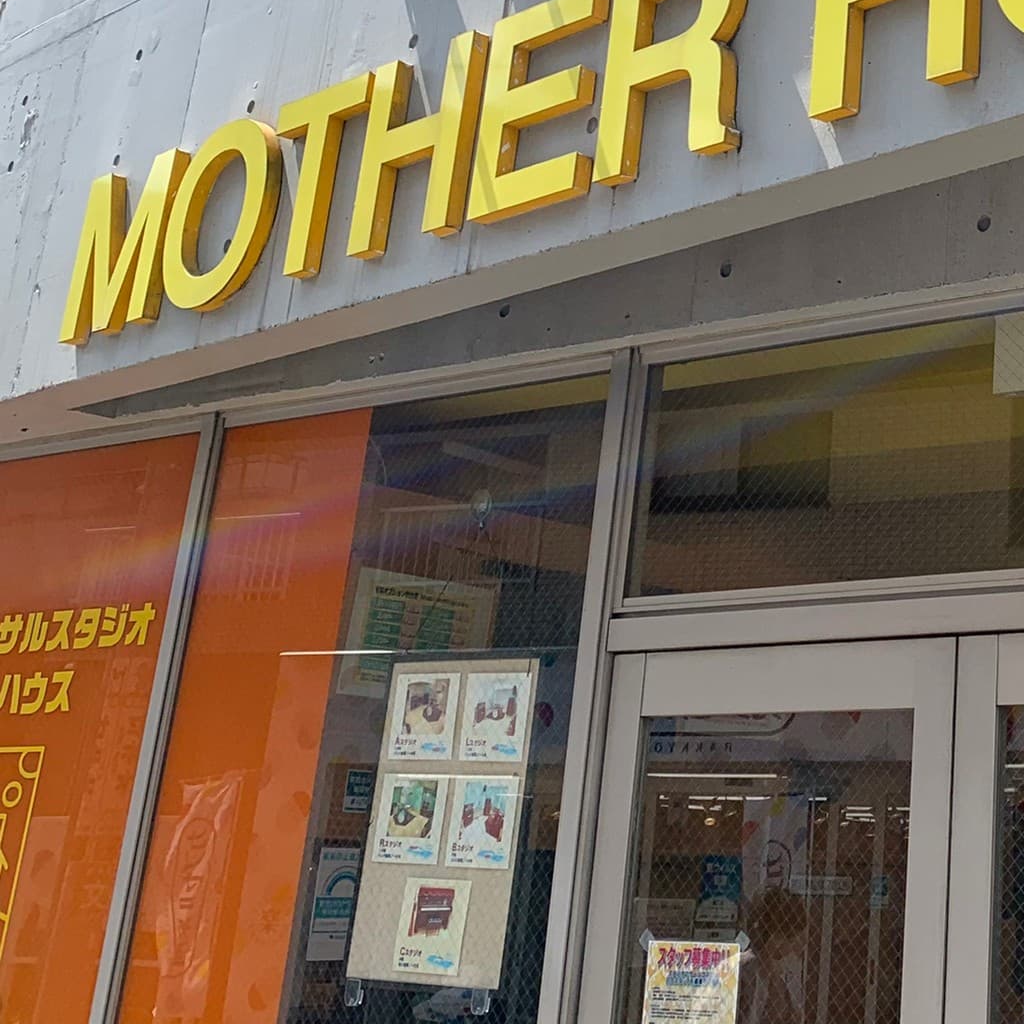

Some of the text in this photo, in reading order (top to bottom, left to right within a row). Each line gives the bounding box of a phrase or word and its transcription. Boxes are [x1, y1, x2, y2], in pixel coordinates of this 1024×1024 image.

[0, 602, 157, 654] サルスタジオ
